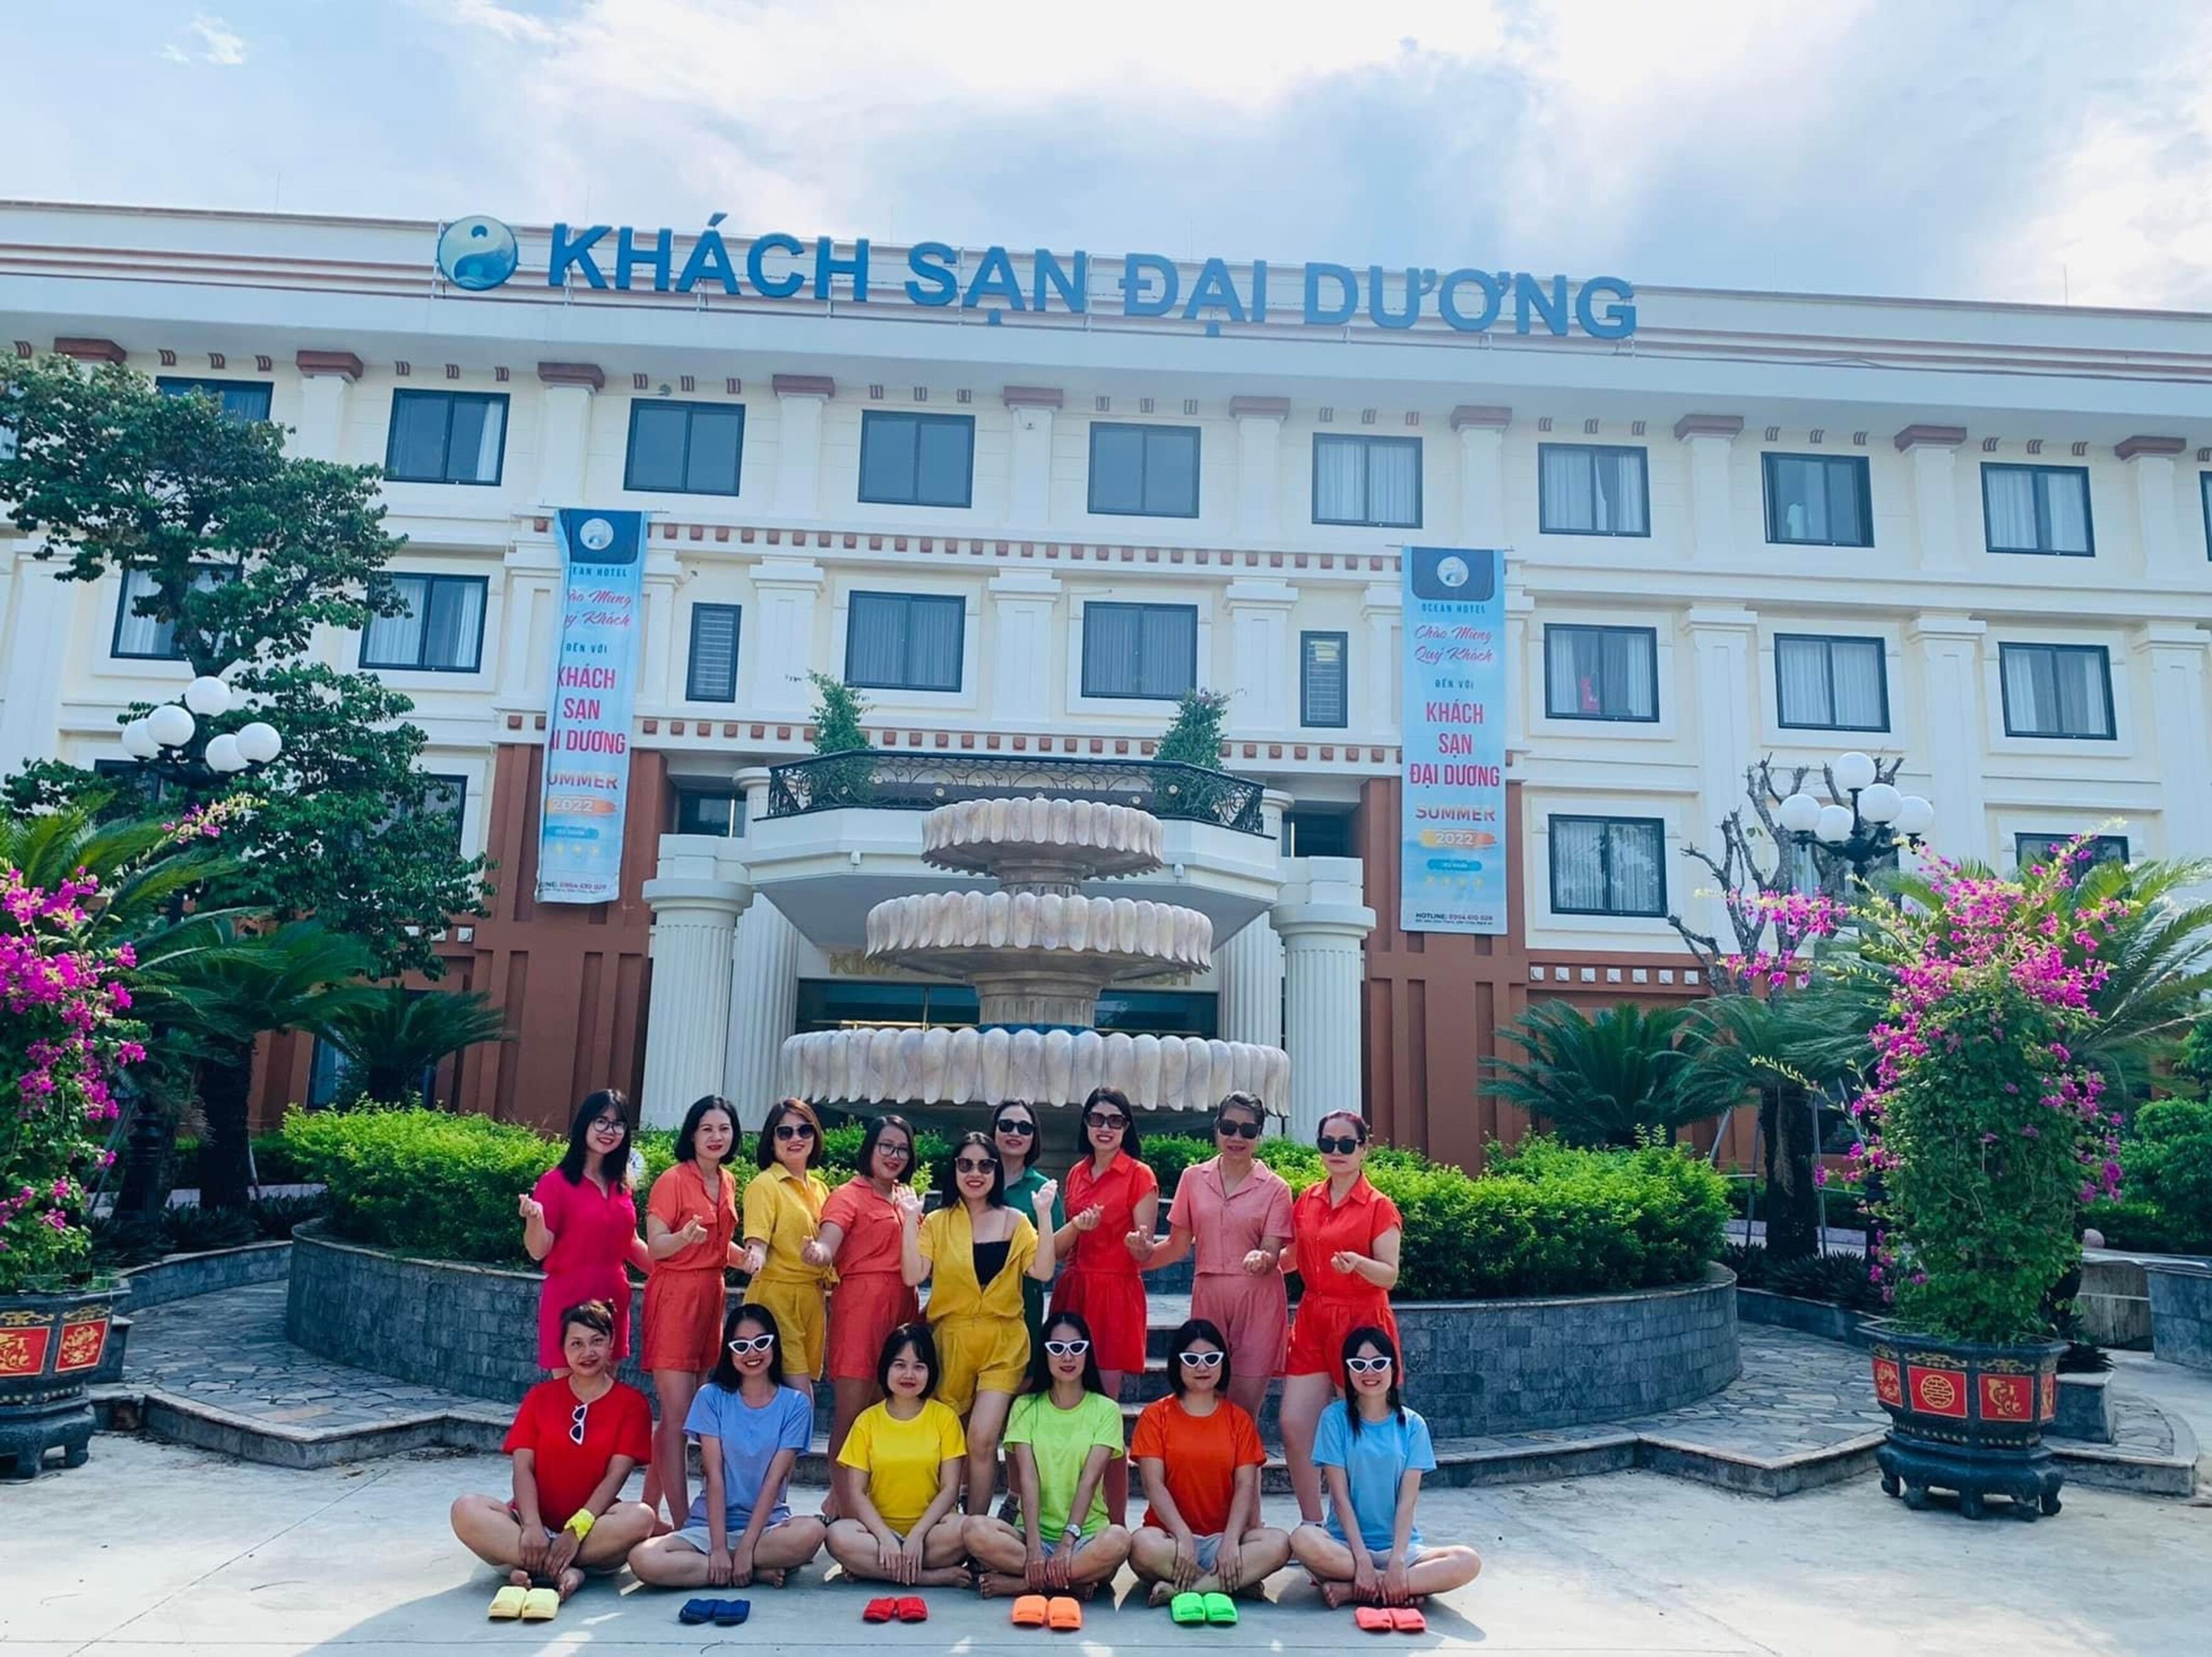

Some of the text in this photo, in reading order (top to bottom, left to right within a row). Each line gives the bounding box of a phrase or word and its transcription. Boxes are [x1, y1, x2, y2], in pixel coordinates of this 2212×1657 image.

[547, 212, 1637, 339] KHÁCH SẠN ĐẠI DƯƠNG
[597, 568, 627, 577] HOTEL
[1421, 603, 1486, 614] OCEAN HOTEL
[582, 611, 630, 625] Khách
[1415, 624, 1448, 639] Chào
[1415, 646, 1493, 665] Quý Khách
[557, 663, 616, 689] KHÁCH
[563, 697, 600, 723] SẠN
[1426, 698, 1484, 724] KHÁCH
[566, 730, 625, 754] DƯƠNG
[1439, 733, 1472, 758] SẠN
[547, 772, 617, 789] UMMER
[1409, 763, 1500, 788] ĐẠI DƯƠNG
[553, 799, 593, 813] 2022
[1416, 805, 1496, 822] SUMMER
[1436, 833, 1474, 846] 2022
